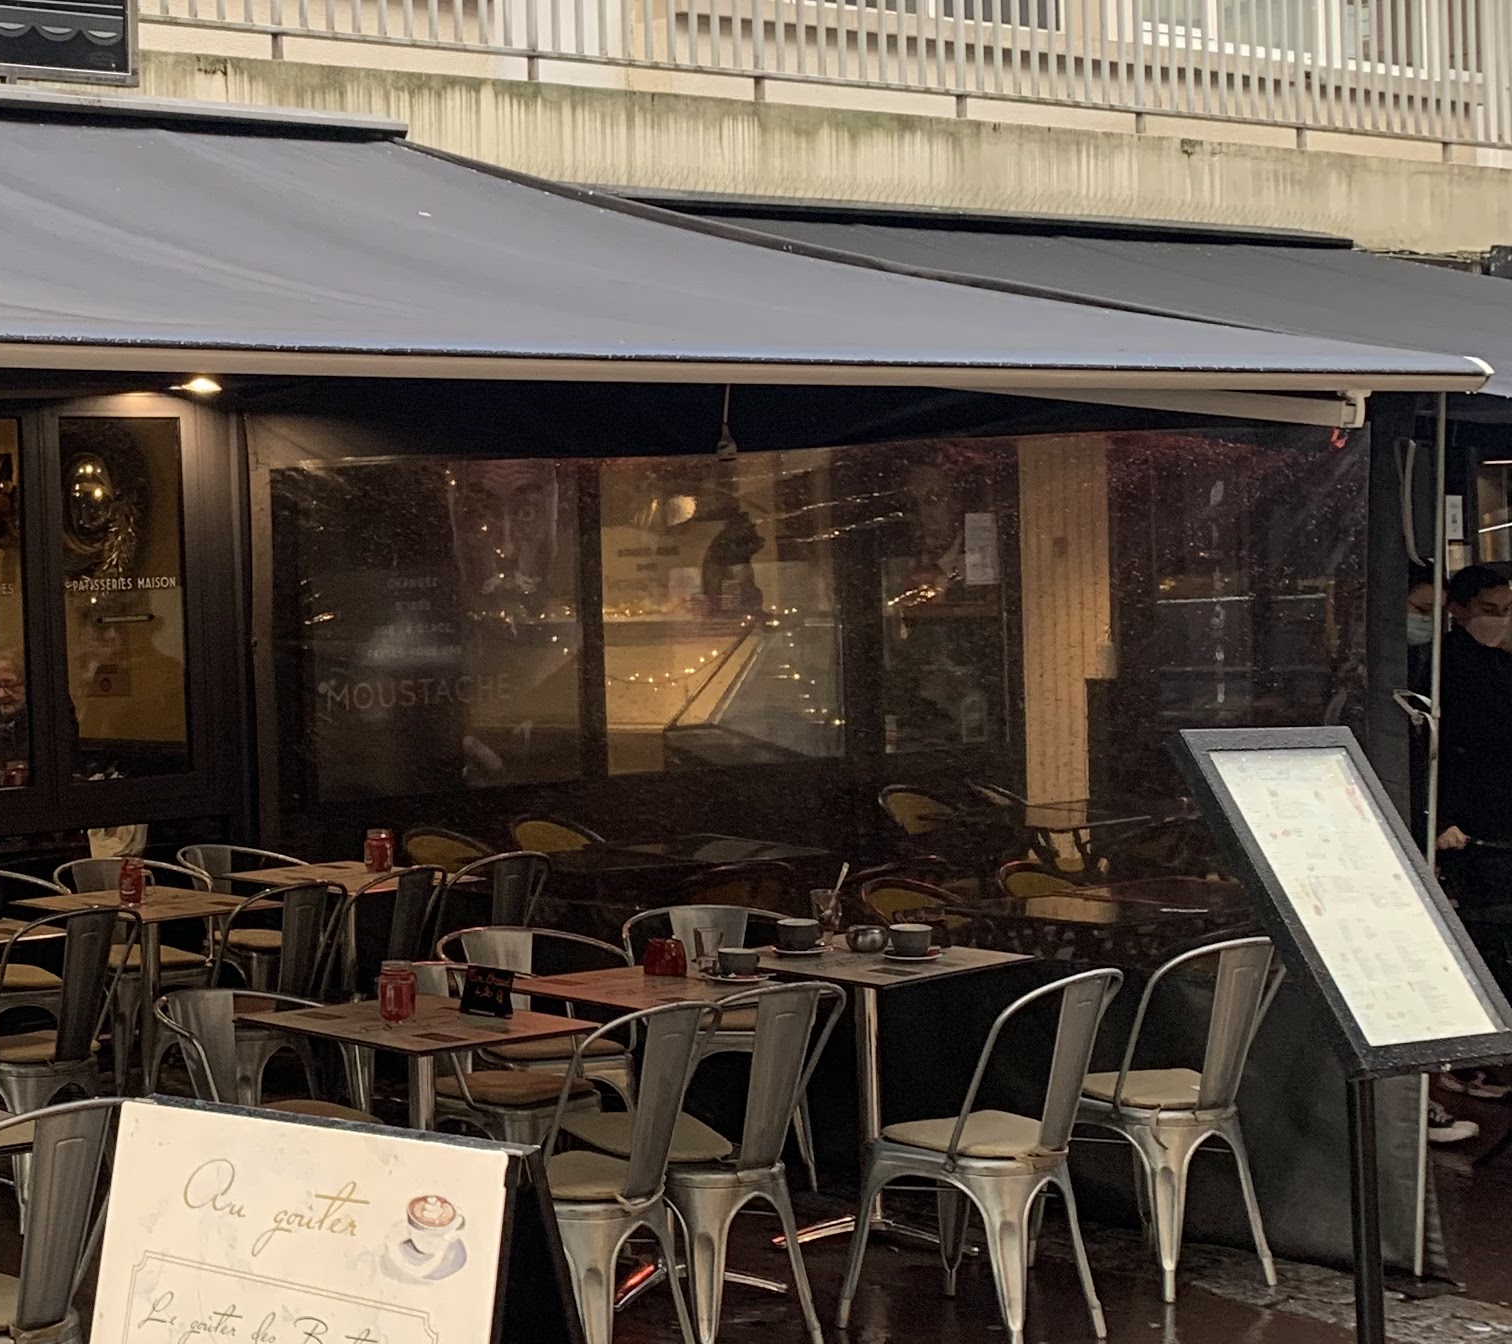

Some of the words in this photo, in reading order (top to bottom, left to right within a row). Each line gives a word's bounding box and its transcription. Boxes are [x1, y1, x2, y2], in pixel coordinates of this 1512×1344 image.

[138, 576, 176, 589] MAISON
[322, 673, 511, 711] MOUSTACHE
[183, 1159, 246, 1217] Au
[251, 1181, 370, 1257] goûter
[138, 1291, 176, 1329] Le
[250, 1312, 276, 1344] des
